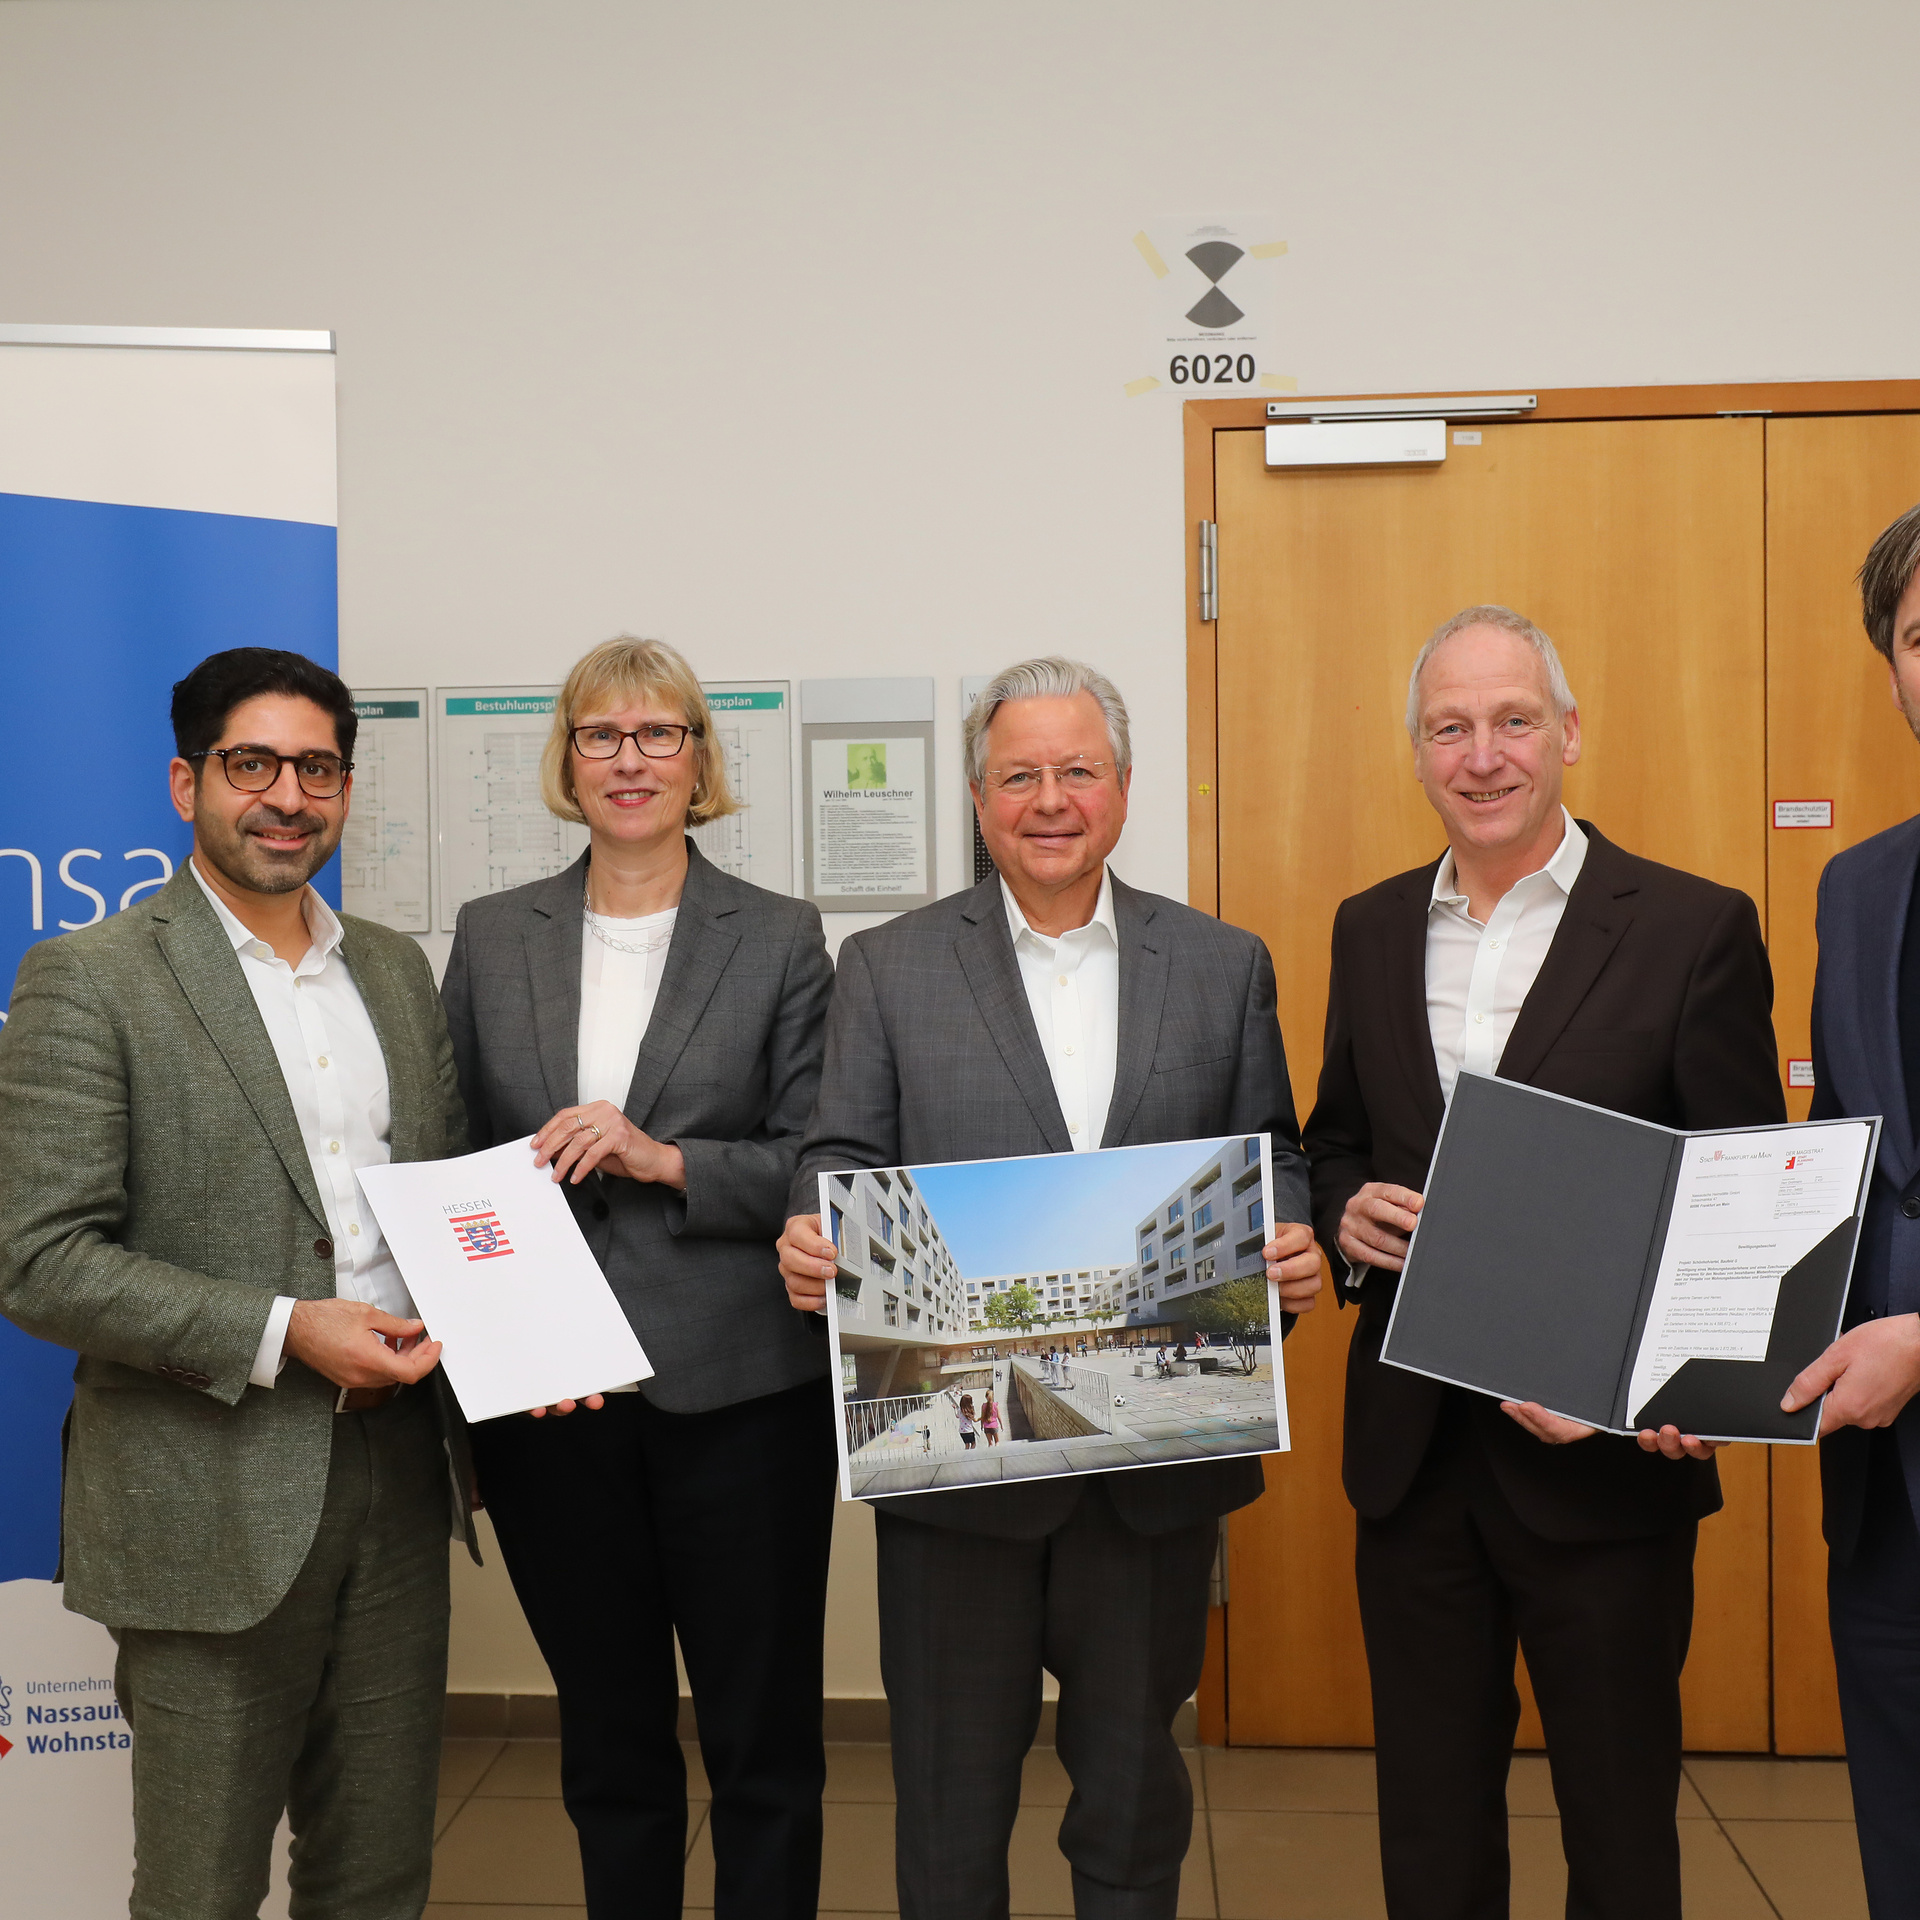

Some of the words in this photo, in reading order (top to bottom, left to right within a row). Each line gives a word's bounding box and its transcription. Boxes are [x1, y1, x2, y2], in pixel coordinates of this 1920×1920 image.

[1170, 354, 1255, 384] 6020
[823, 790, 861, 798] Wilhelm
[864, 790, 914, 798] Leuschner
[442, 1198, 493, 1214] HESSEN
[27, 1677, 112, 1694] Unternehm
[27, 1699, 125, 1724] Nassaui
[27, 1731, 131, 1754] Wohnsta
